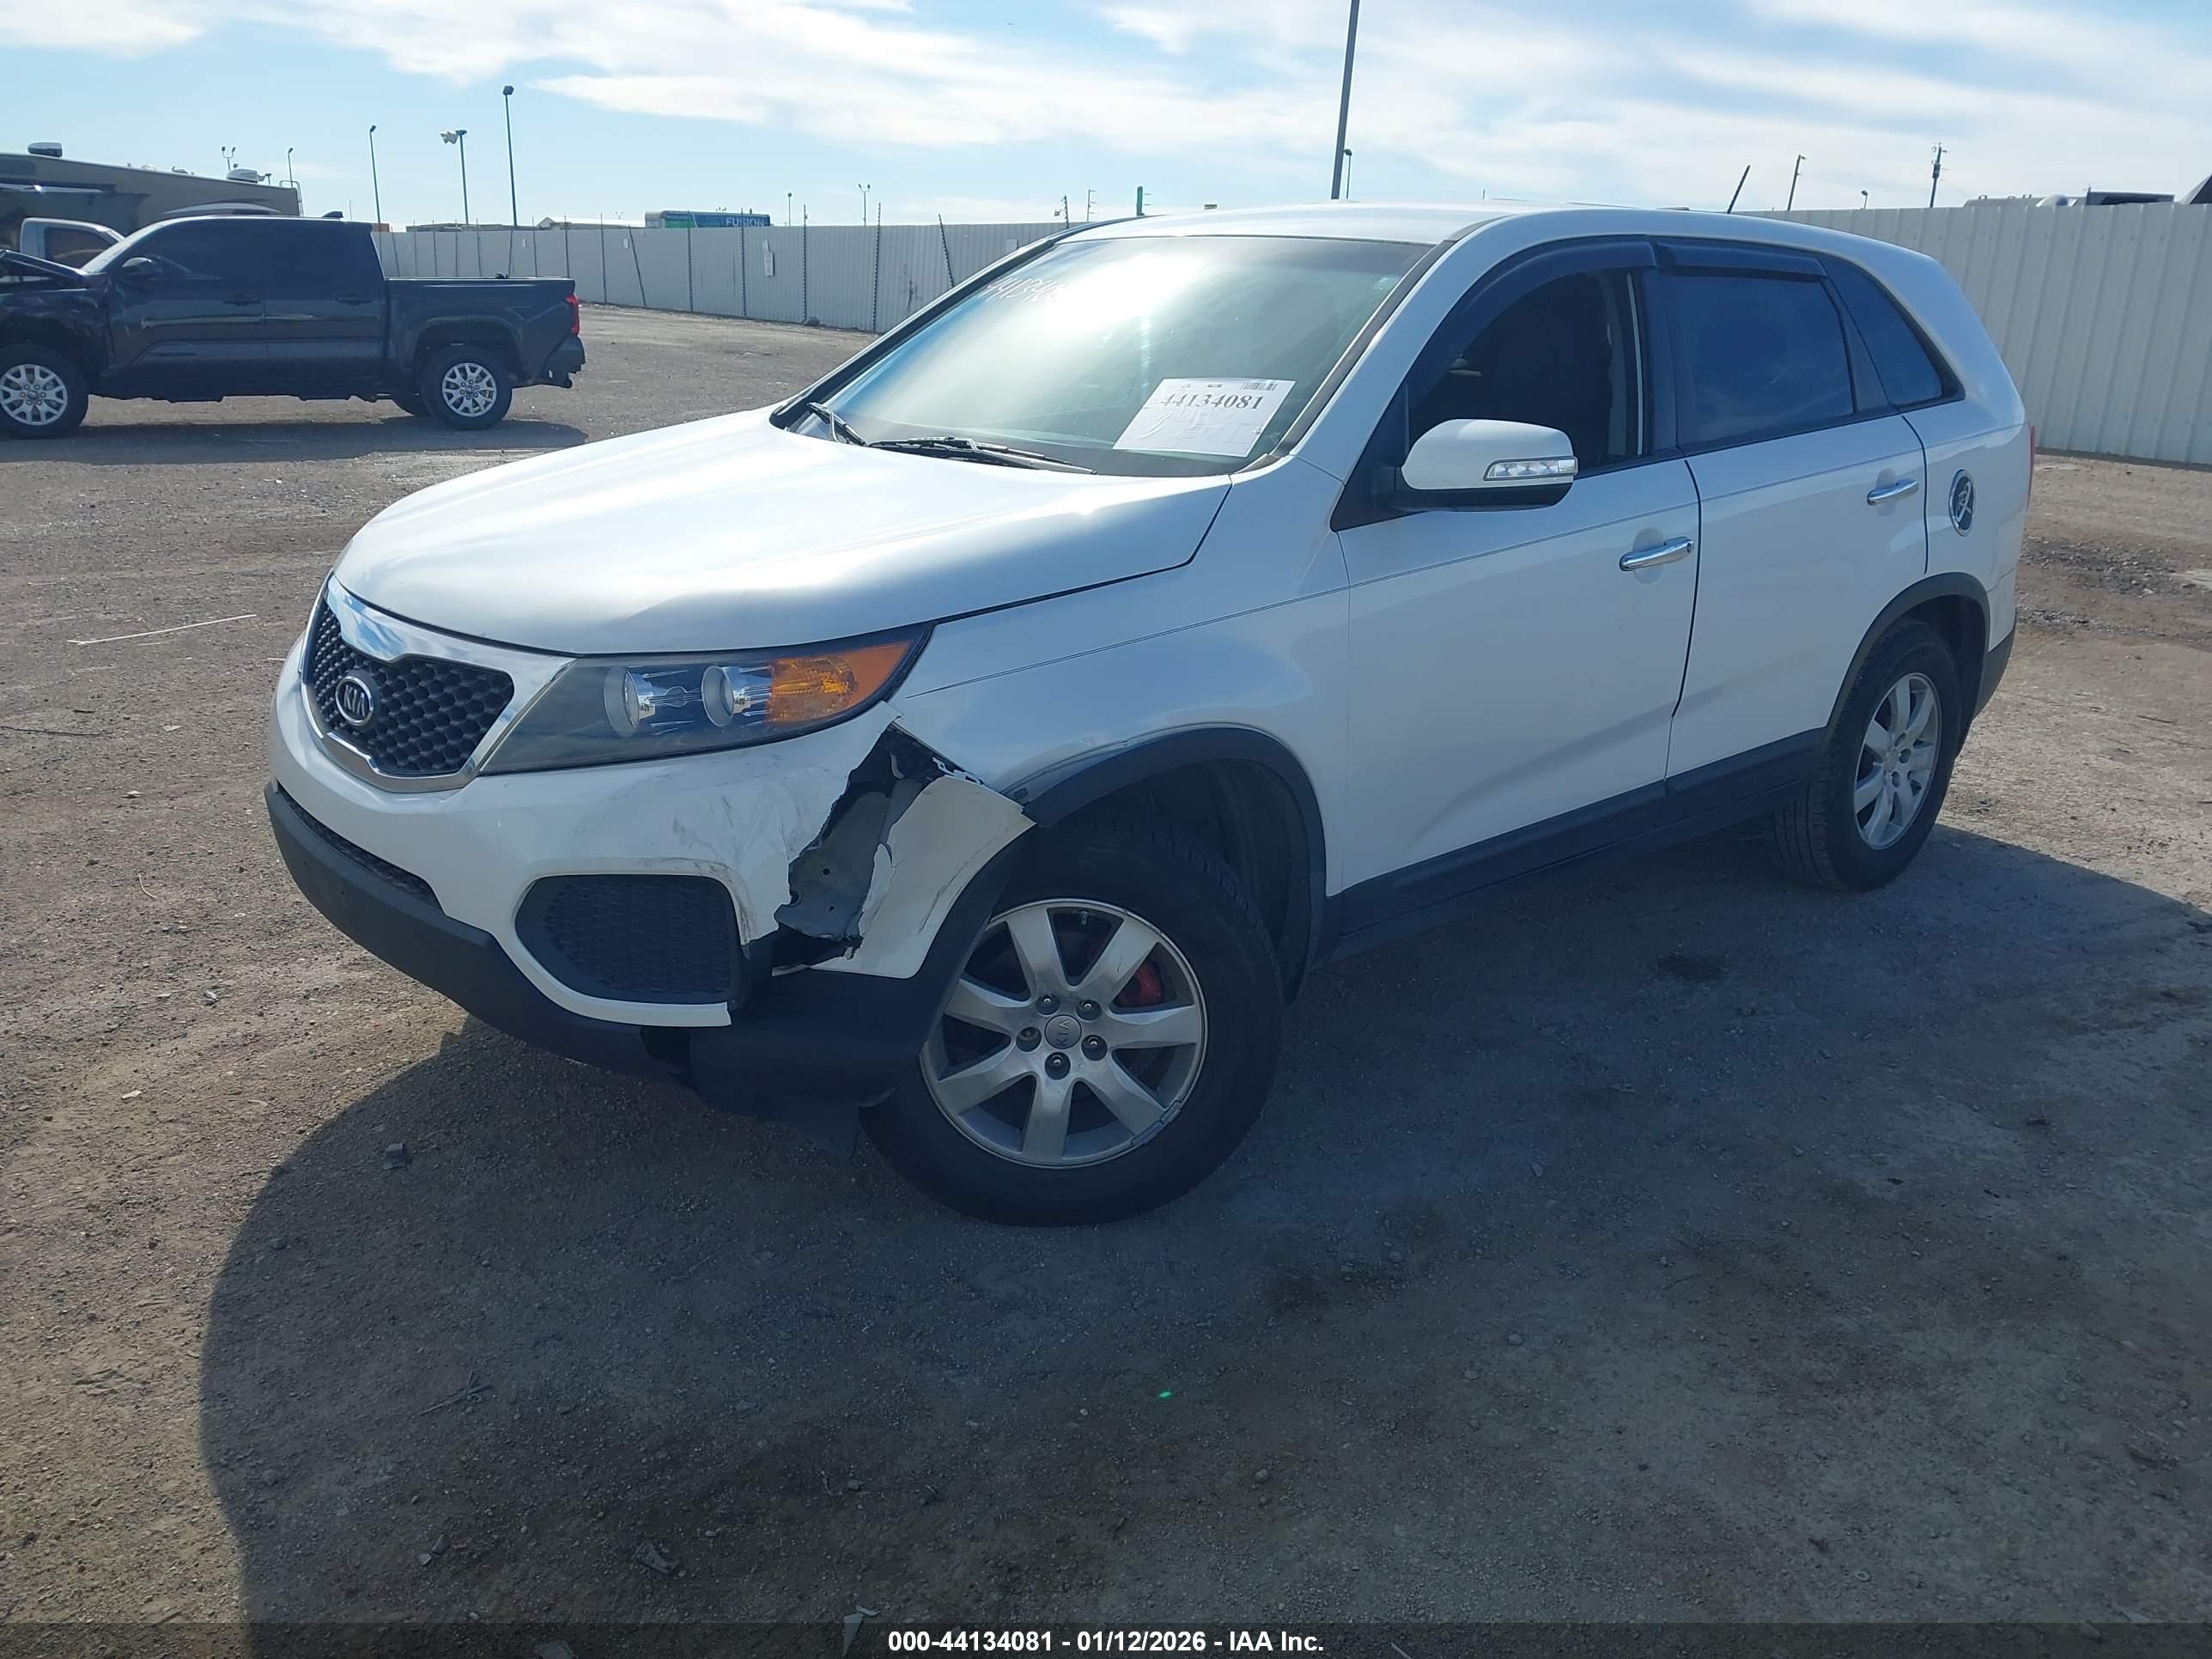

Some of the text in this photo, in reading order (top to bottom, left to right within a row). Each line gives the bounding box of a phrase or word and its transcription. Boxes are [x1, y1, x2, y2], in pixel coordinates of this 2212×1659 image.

[725, 216, 765, 228] FUSION
[1160, 392, 1265, 410] 44134081
[1056, 1019, 1071, 1046] KIA
